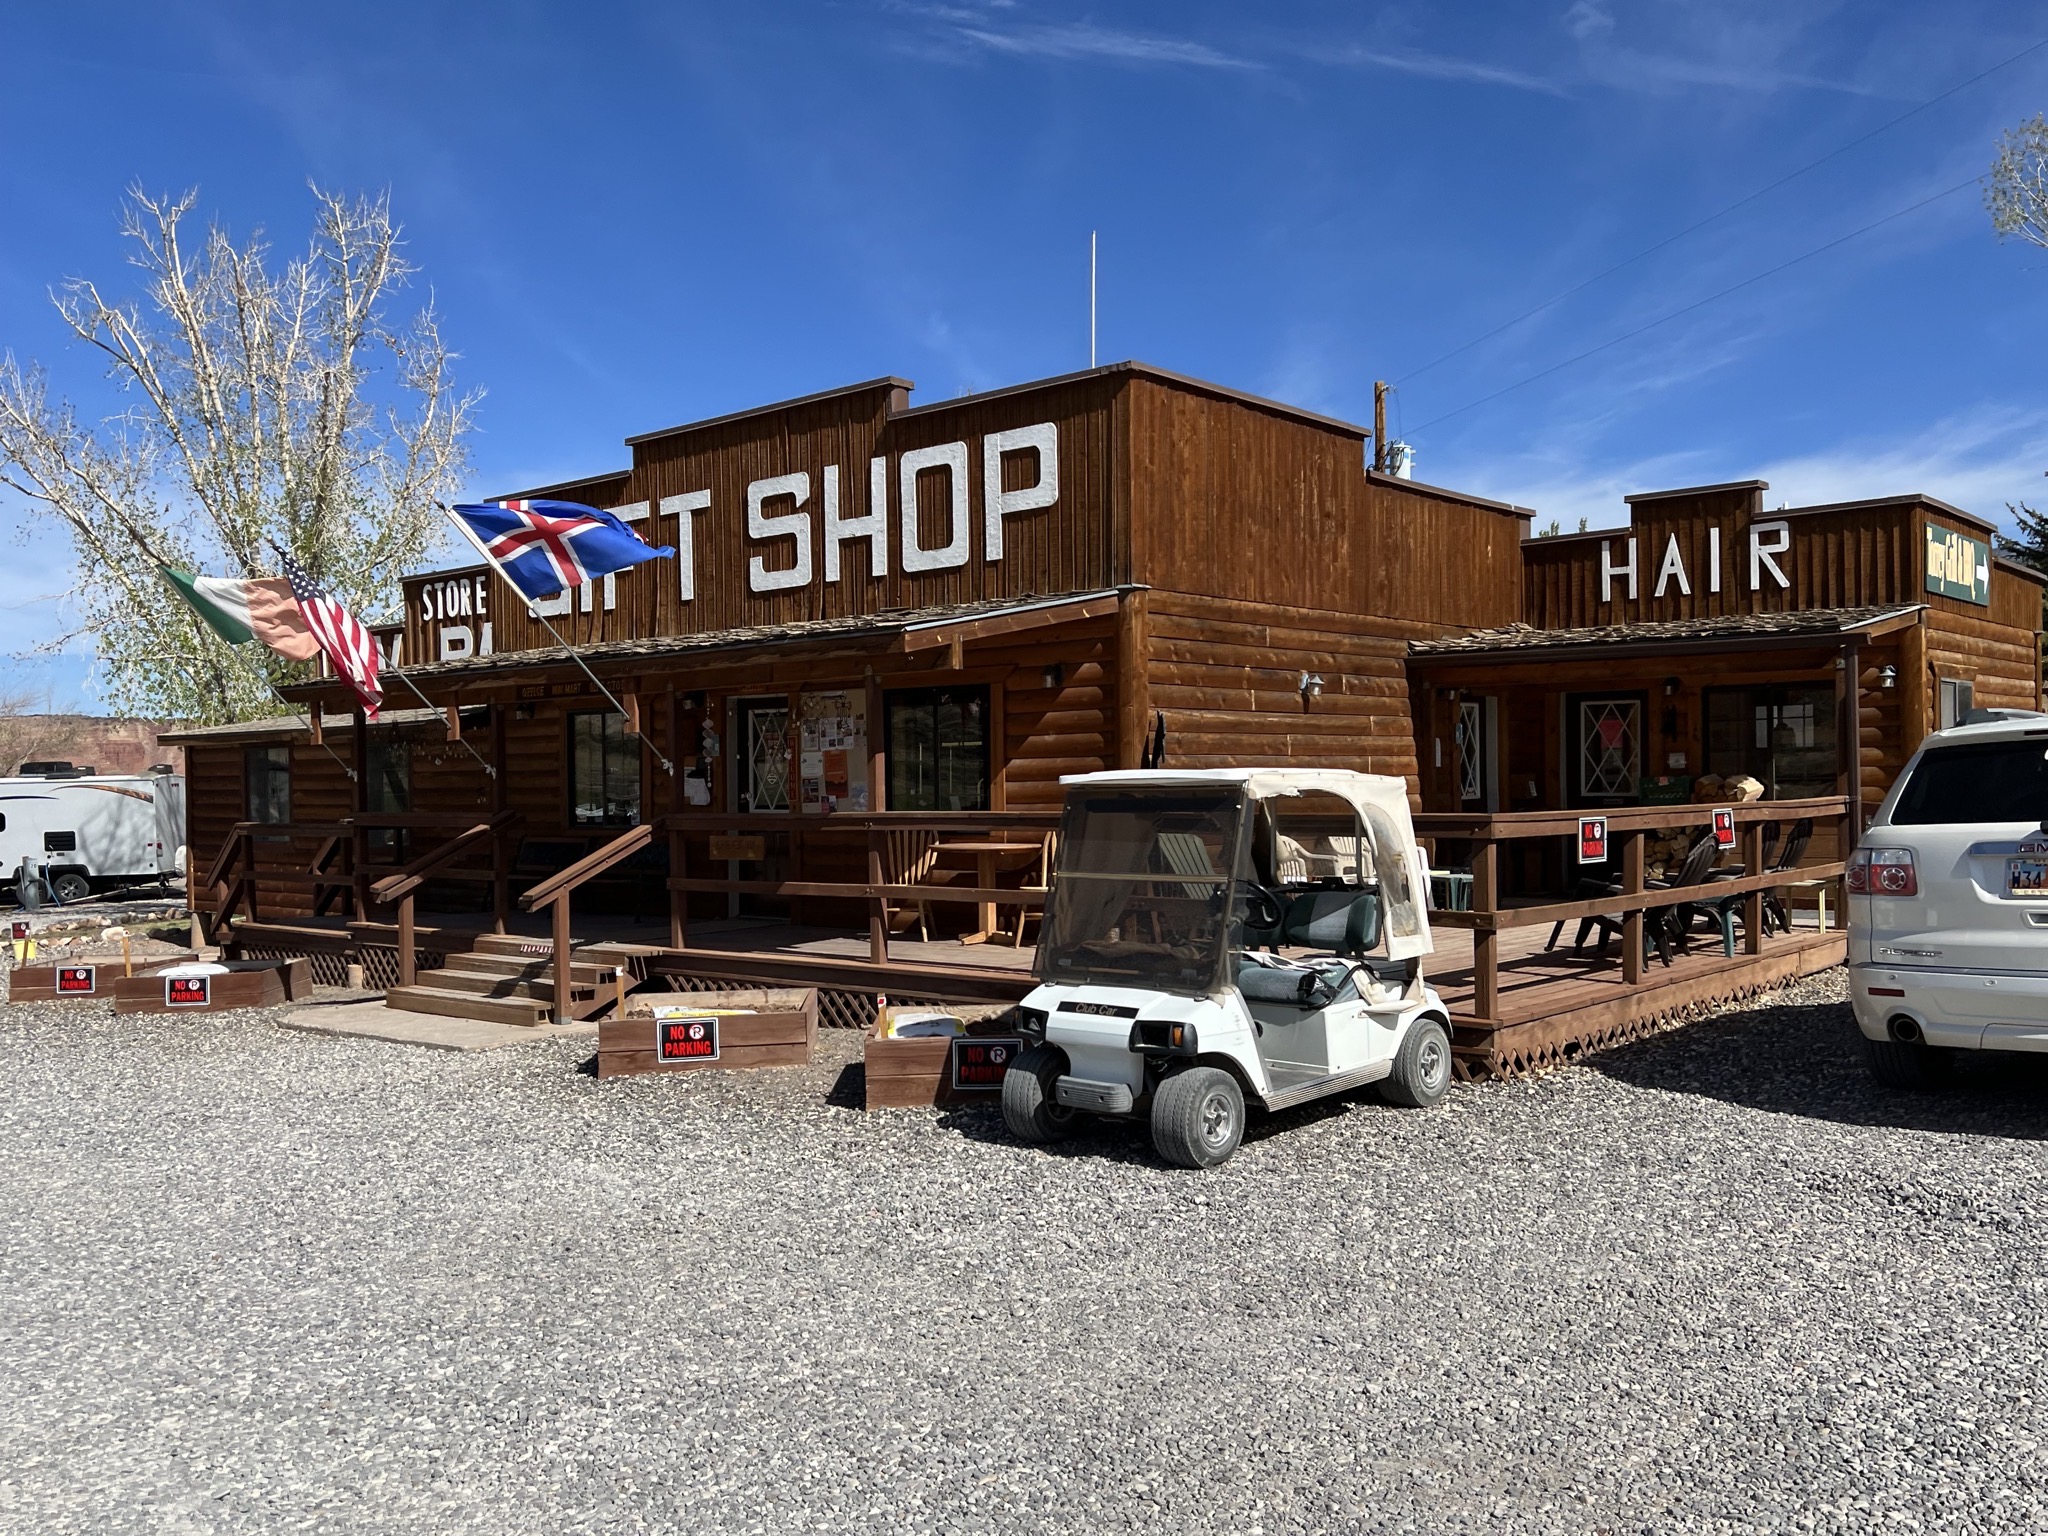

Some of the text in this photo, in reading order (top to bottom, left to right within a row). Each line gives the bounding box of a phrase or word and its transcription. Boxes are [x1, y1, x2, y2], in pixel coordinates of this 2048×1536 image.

[747, 421, 1059, 592] SHOP
[1601, 520, 1790, 602] HAIR
[422, 575, 487, 621] STORE
[1584, 823, 1593, 839] NO
[1583, 841, 1604, 856] PARKING
[64, 970, 74, 979] NO
[61, 980, 90, 990] PARKING
[174, 980, 186, 991] NO
[171, 991, 204, 1002] PARKING
[1075, 1003, 1118, 1015] Club Car
[670, 1025, 685, 1040] NO
[665, 1040, 712, 1056] PARKING
[967, 1046, 984, 1063] NO
[961, 1065, 1006, 1082] PARKIN
